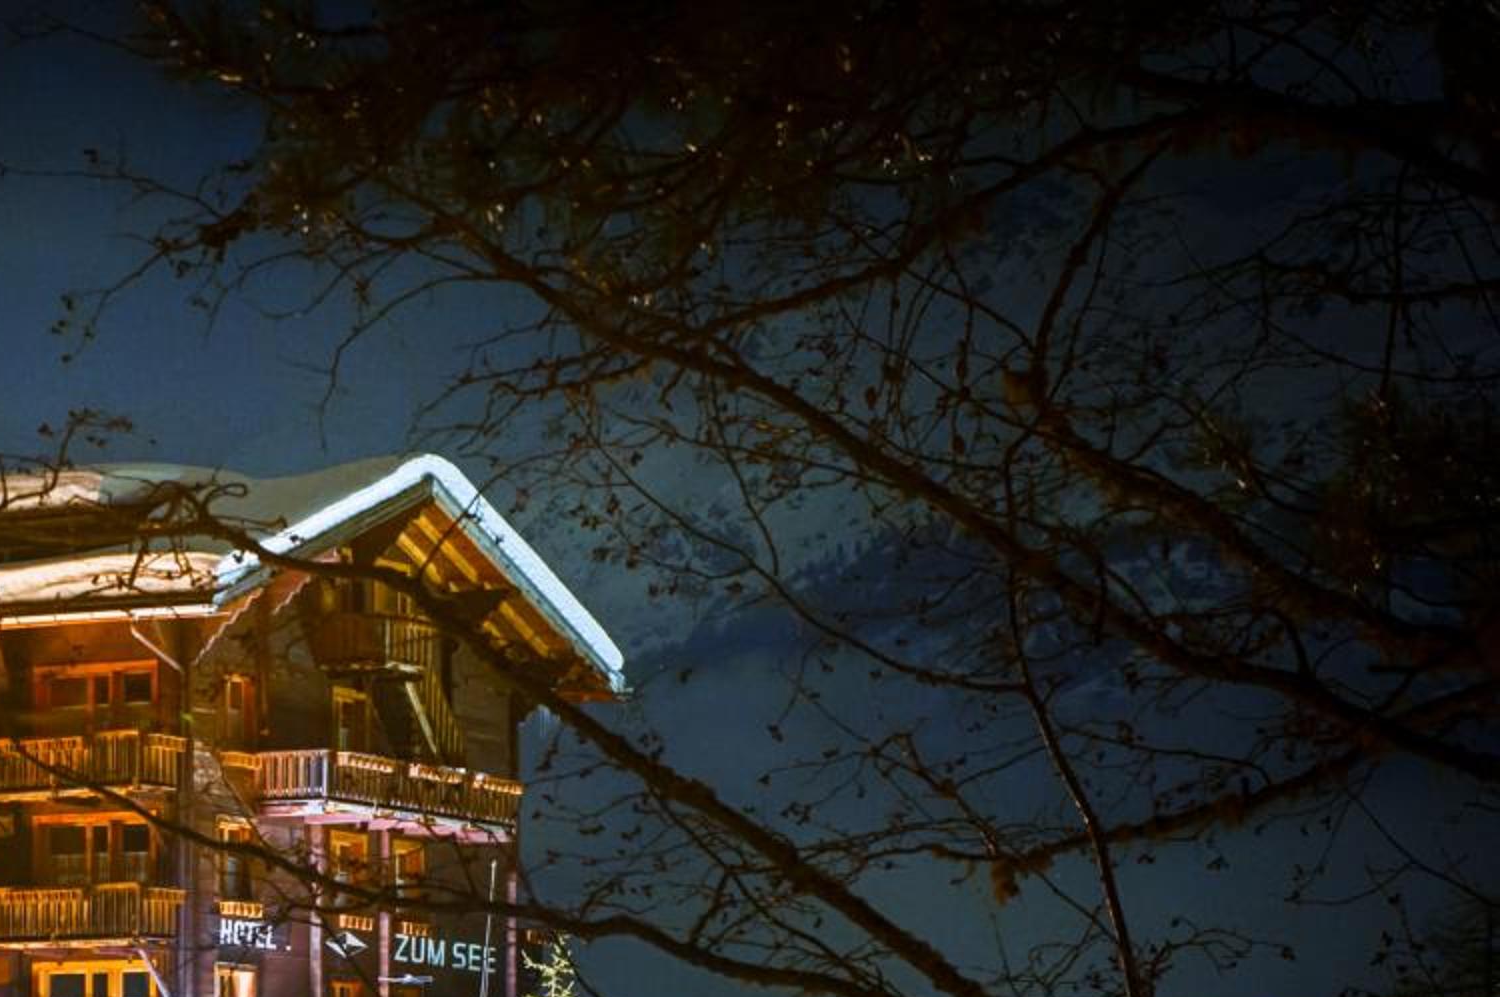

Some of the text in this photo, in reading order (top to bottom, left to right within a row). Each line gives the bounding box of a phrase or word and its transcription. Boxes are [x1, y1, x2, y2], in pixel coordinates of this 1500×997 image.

[220, 919, 497, 974] HOTEL ZUM SEE
